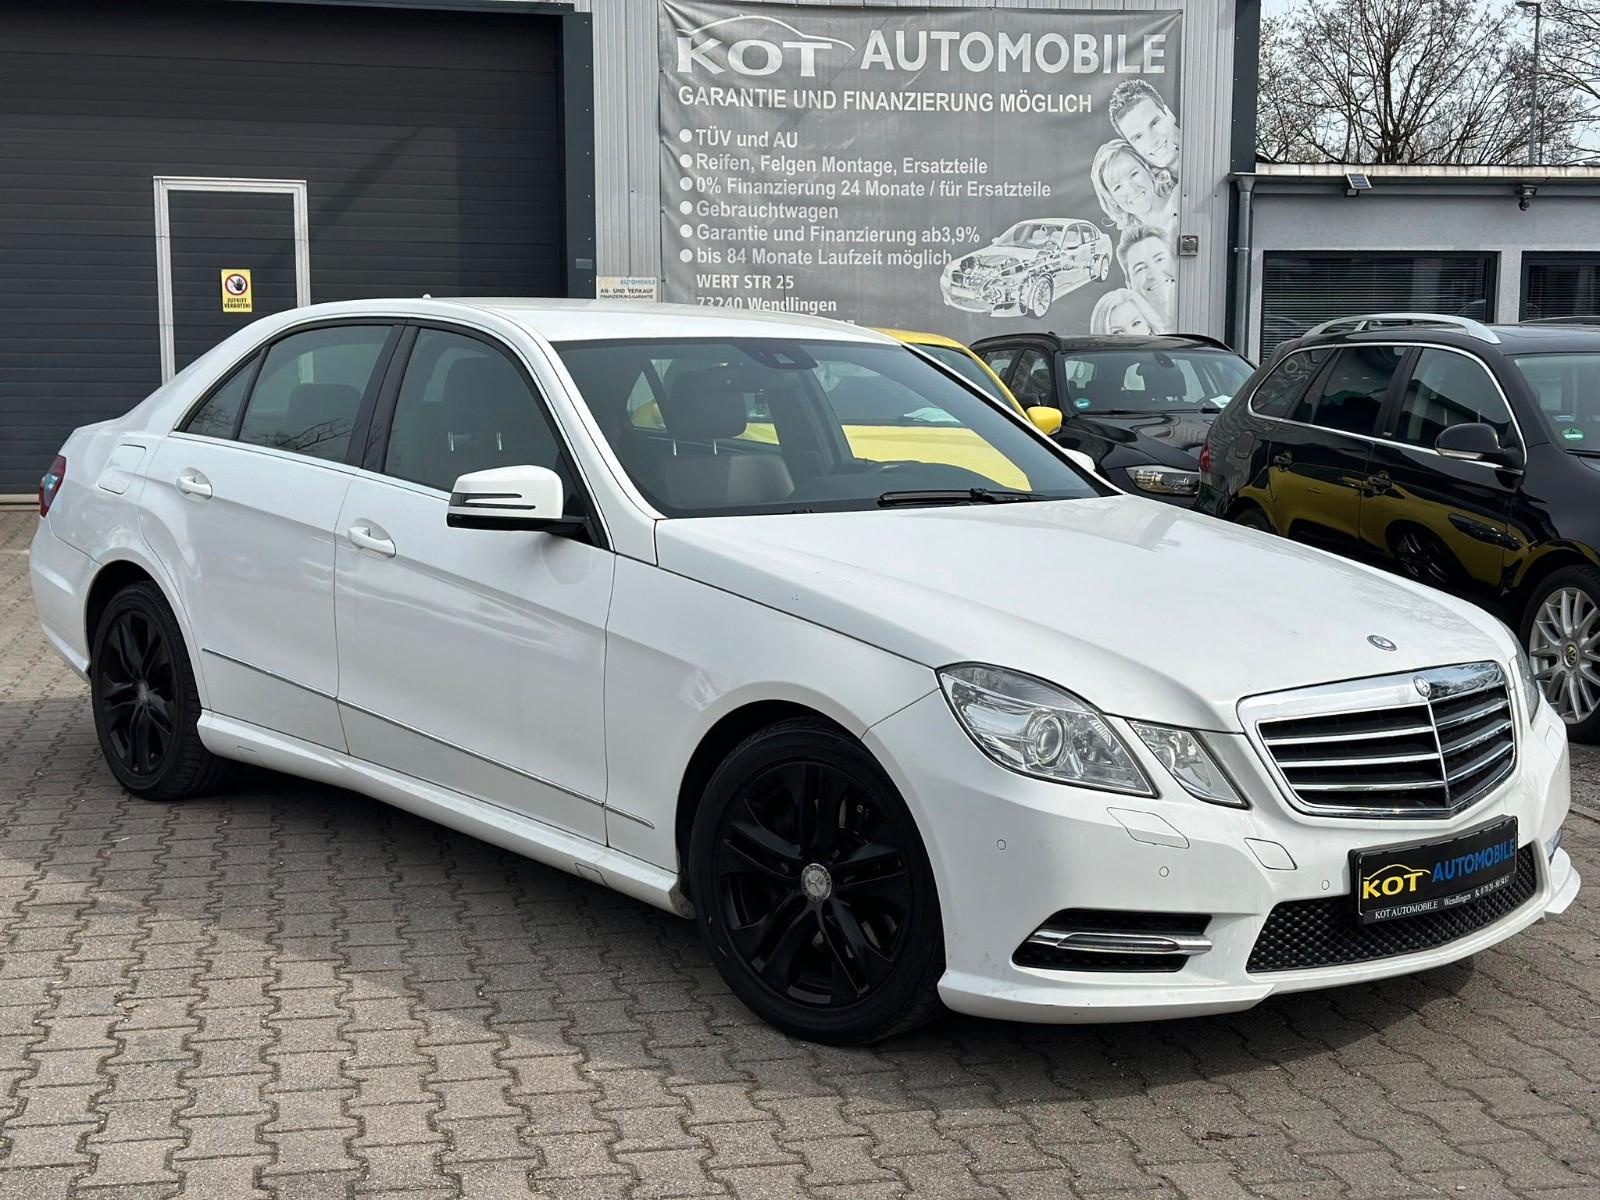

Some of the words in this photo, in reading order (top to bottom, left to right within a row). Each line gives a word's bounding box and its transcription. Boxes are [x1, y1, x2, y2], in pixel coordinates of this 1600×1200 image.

[677, 36, 833, 77] KOT
[860, 30, 1166, 74] AUTOMOBILE
[678, 86, 787, 108] GARANTIE
[794, 90, 836, 109] UND
[843, 91, 993, 112] FINANZIERUNG
[1000, 89, 1092, 113] MÖGLICH
[696, 126, 731, 146] TÜV
[737, 131, 769, 147] und
[773, 131, 798, 148] AU
[696, 153, 755, 174] Reifen,
[761, 155, 817, 175] Felgen
[822, 156, 897, 177] Montage,
[903, 157, 988, 174] Ersatzteile
[696, 177, 722, 194] 0%
[727, 178, 836, 200] Finanzierung
[841, 180, 860, 196] 24
[865, 180, 925, 197] Monate
[929, 180, 935, 197] /
[939, 180, 963, 197] für
[967, 181, 1051, 197] Ersatzteile
[696, 200, 839, 222] Gebrauchtwagen
[697, 223, 769, 241] Garantie
[773, 226, 804, 242] und
[810, 226, 917, 245] Finanzierung
[921, 226, 980, 245] ab3,9%
[697, 247, 722, 264] bis
[727, 248, 747, 264] 84
[752, 248, 812, 265] Monate
[818, 249, 883, 266] Laufzeit
[887, 249, 952, 269] möglich
[696, 274, 739, 289] WERT
[744, 274, 772, 289] STR
[776, 275, 794, 289] 25
[747, 297, 837, 315] Wendlingen
[1363, 872, 1423, 899] KOT
[1432, 837, 1516, 883] AUTOMOBILE
[1375, 908, 1391, 919] KOT
[1391, 901, 1439, 916] AUTOMOBILE
